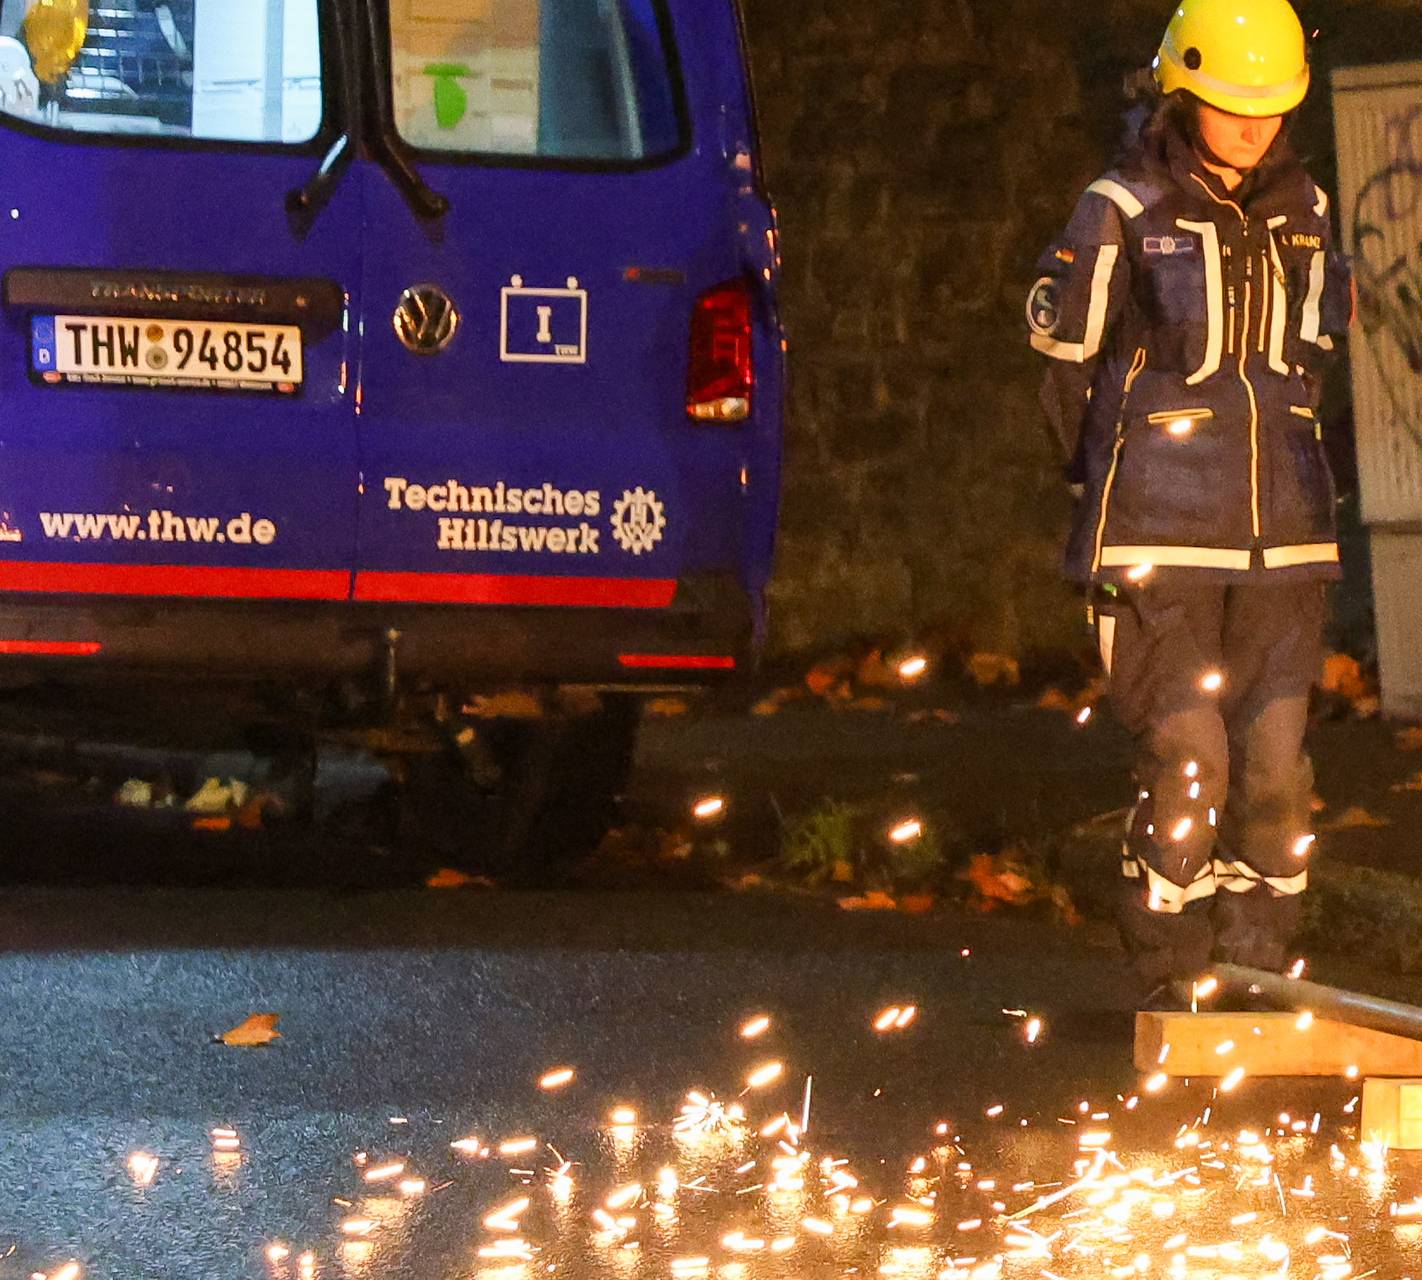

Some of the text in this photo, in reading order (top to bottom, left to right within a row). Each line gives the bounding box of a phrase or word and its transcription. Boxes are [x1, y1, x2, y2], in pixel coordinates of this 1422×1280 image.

[64, 323, 292, 376] THW 94854
[384, 476, 601, 516] Technisches
[39, 509, 277, 544] www.thw.de
[437, 517, 600, 553] Hilfswerk
